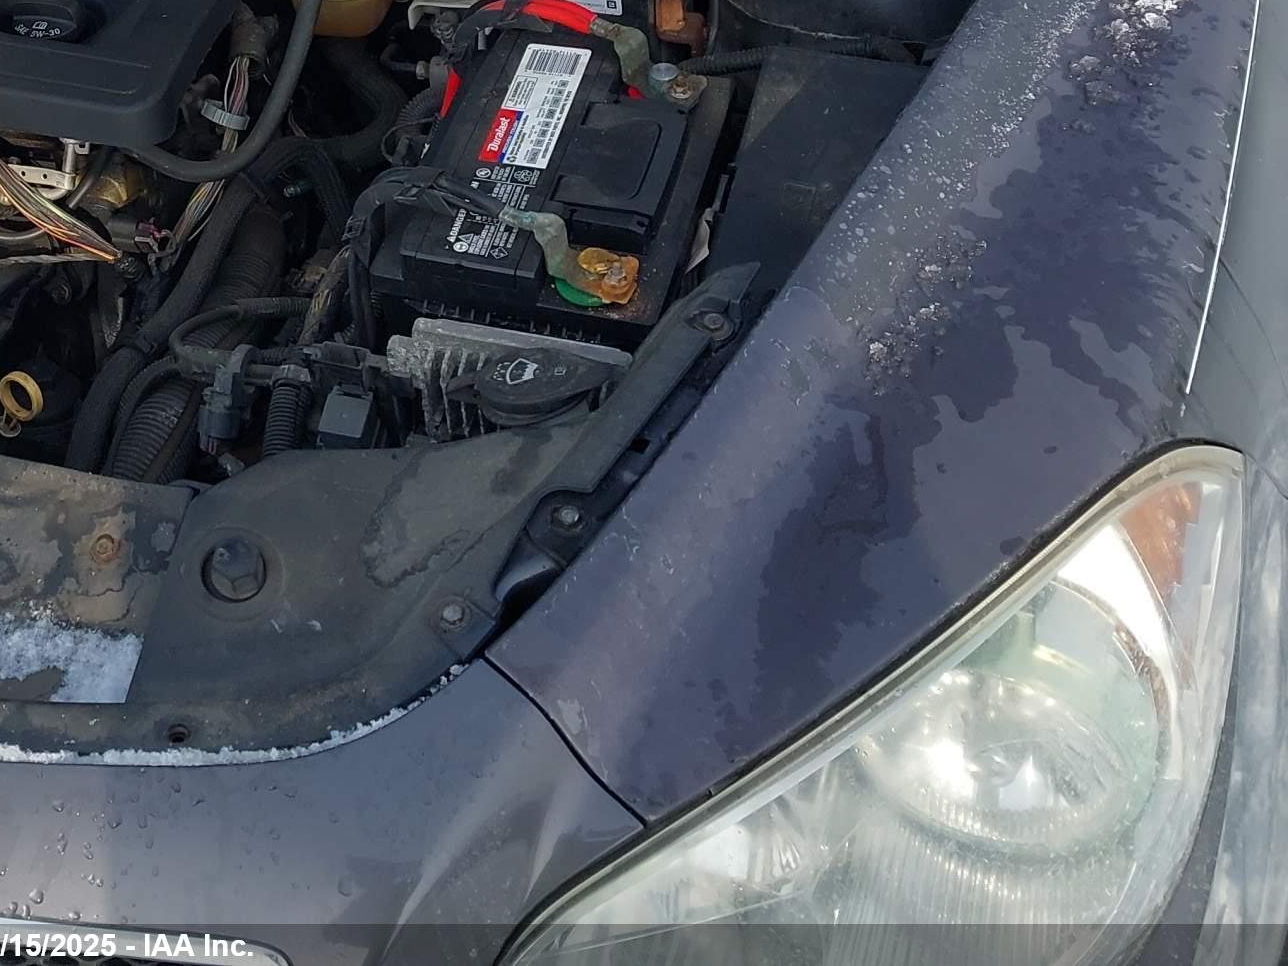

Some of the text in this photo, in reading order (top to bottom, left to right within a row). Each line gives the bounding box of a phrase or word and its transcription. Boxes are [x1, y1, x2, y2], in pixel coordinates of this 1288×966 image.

[14, 23, 61, 38] SAE 5W-30
[487, 117, 511, 152] Duralast
